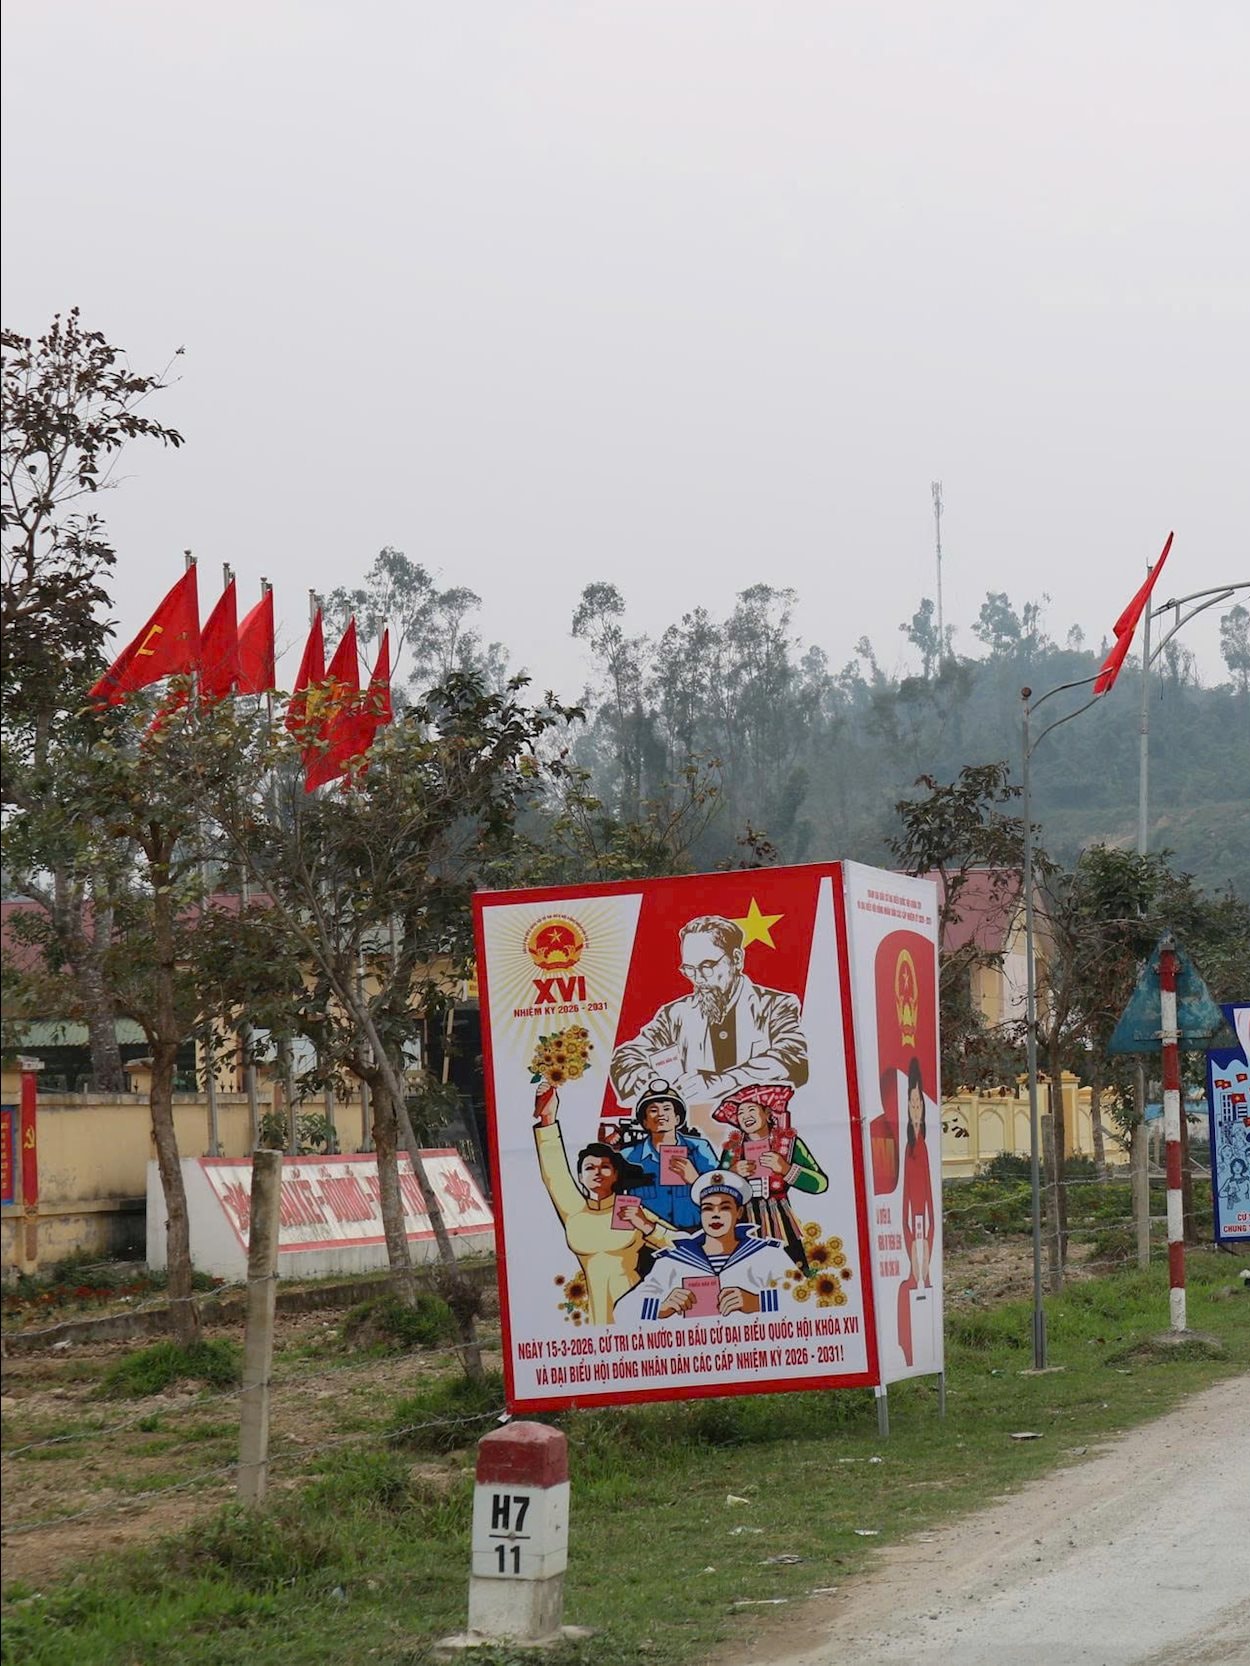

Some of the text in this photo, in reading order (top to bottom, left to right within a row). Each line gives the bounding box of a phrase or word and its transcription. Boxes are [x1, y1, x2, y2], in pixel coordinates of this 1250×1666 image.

[532, 975, 586, 1005] XVI
[513, 1006, 542, 1018] NHIỆM
[558, 1004, 579, 1014] 2026
[588, 1002, 608, 1011] 2031
[1223, 1224, 1247, 1233] CHUNG
[518, 1314, 859, 1360] NGÀY 15-3-2026, CỬ TRI CẢ NƯỚC ĐI BẦU CỬ ĐẠI BIỂU QUỐC HỘI KHÓA XVI
[535, 1364, 549, 1386] VÀ
[551, 1366, 567, 1388] ĐẠI
[570, 1358, 591, 1382] BIỂU
[594, 1359, 610, 1384] HỘI
[612, 1356, 639, 1380] ĐỒNG
[641, 1355, 668, 1377] NHÂN
[670, 1353, 691, 1374] DÂN
[693, 1350, 712, 1373] CÁC
[714, 1348, 734, 1371] CẤP
[736, 1347, 768, 1372] NHIỆM
[770, 1345, 783, 1367] KỲ
[785, 1348, 808, 1366] 2026
[818, 1345, 844, 1363] 2031!
[491, 1494, 530, 1532] H7
[494, 1544, 520, 1574] 11
